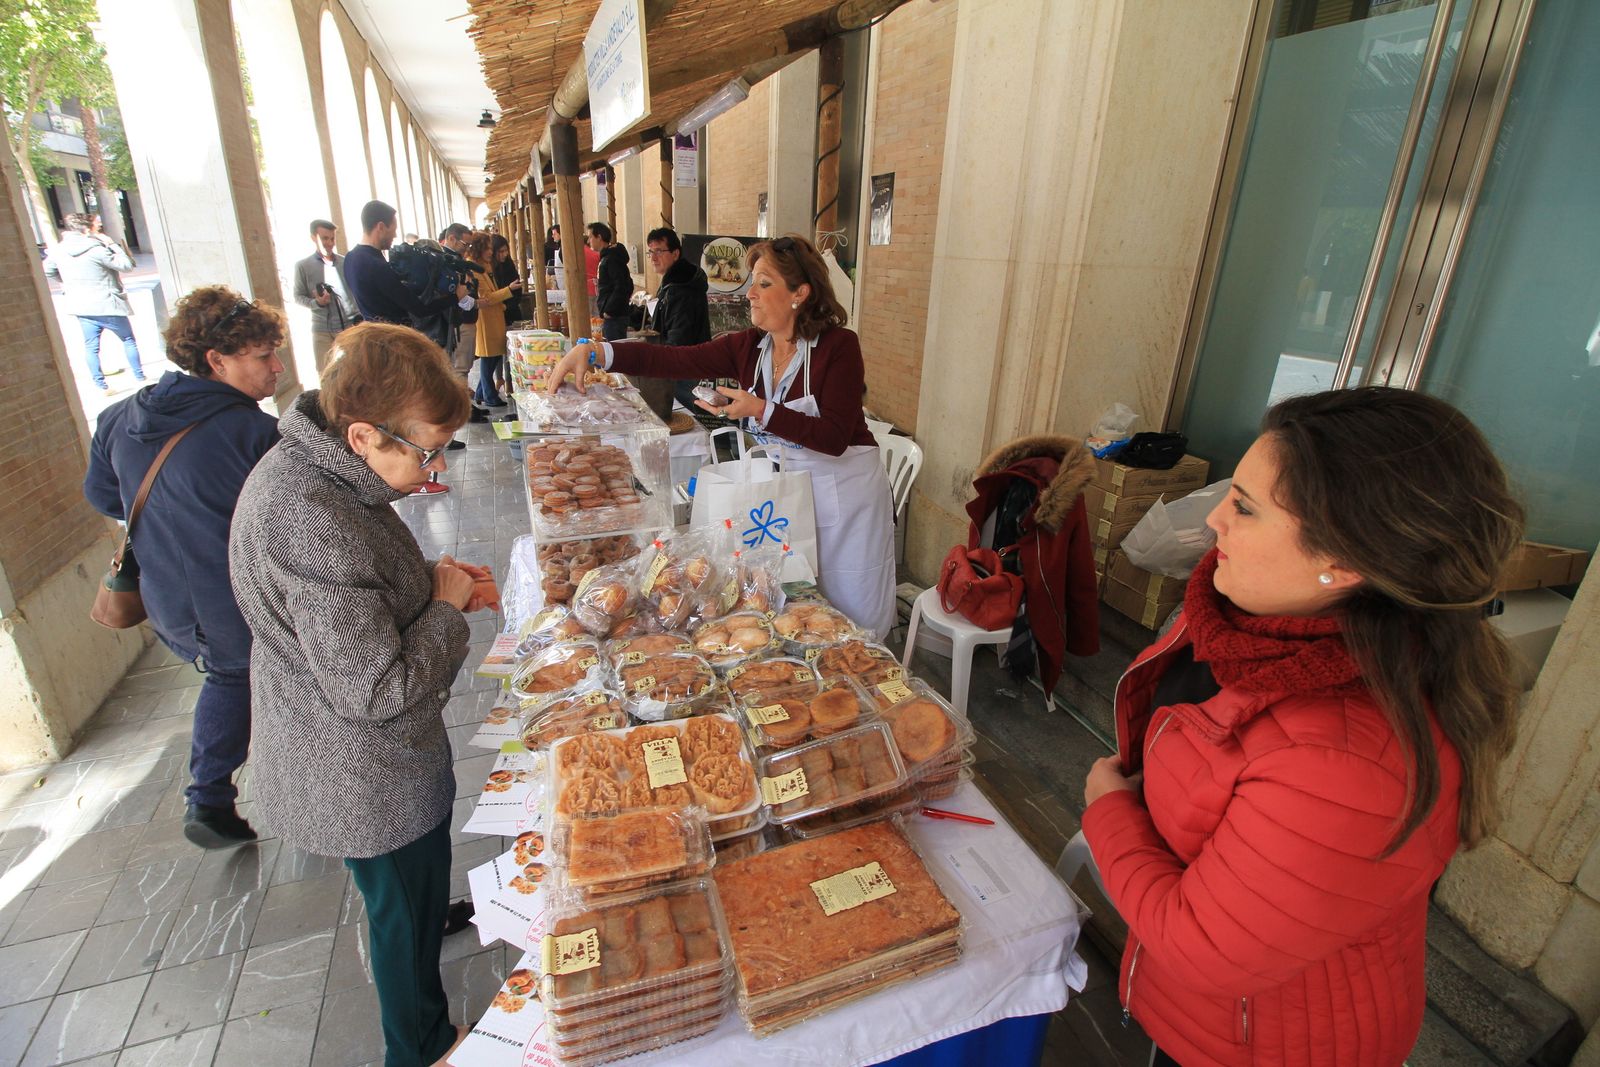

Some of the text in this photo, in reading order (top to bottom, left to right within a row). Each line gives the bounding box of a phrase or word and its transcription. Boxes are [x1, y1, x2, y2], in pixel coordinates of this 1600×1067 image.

[796, 772, 805, 792] VILLA
[878, 868, 891, 887] VILLA
[587, 934, 595, 963] VILLA
